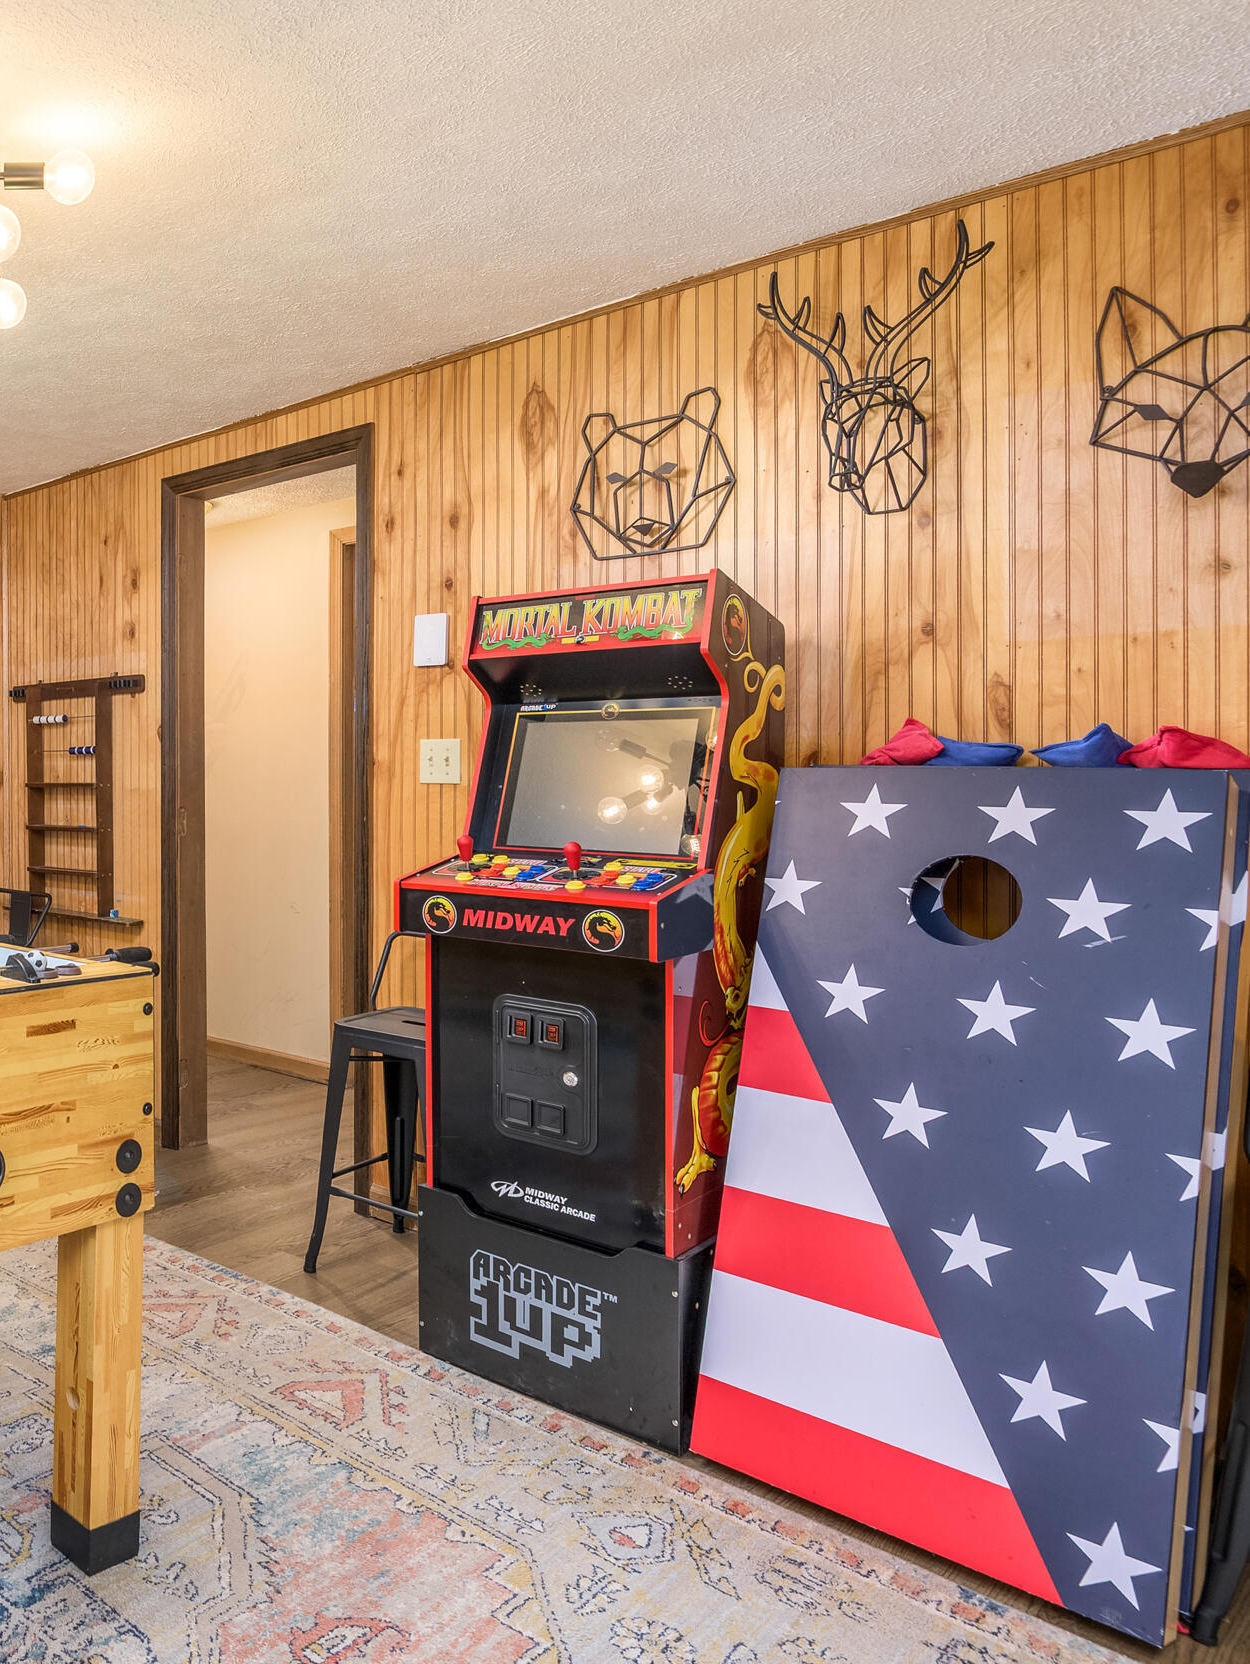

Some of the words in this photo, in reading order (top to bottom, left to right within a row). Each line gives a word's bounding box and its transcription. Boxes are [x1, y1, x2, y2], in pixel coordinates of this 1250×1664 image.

[480, 602, 577, 644] MORTAL
[581, 588, 702, 636] KOMBAT
[462, 908, 576, 937] MIDWAY
[523, 1195, 560, 1211] CLASSIC
[560, 1206, 597, 1222] ARCADE
[525, 1187, 568, 1205] MIDWAY
[470, 1249, 601, 1323] ARCADE
[470, 1280, 601, 1368] 1UP
